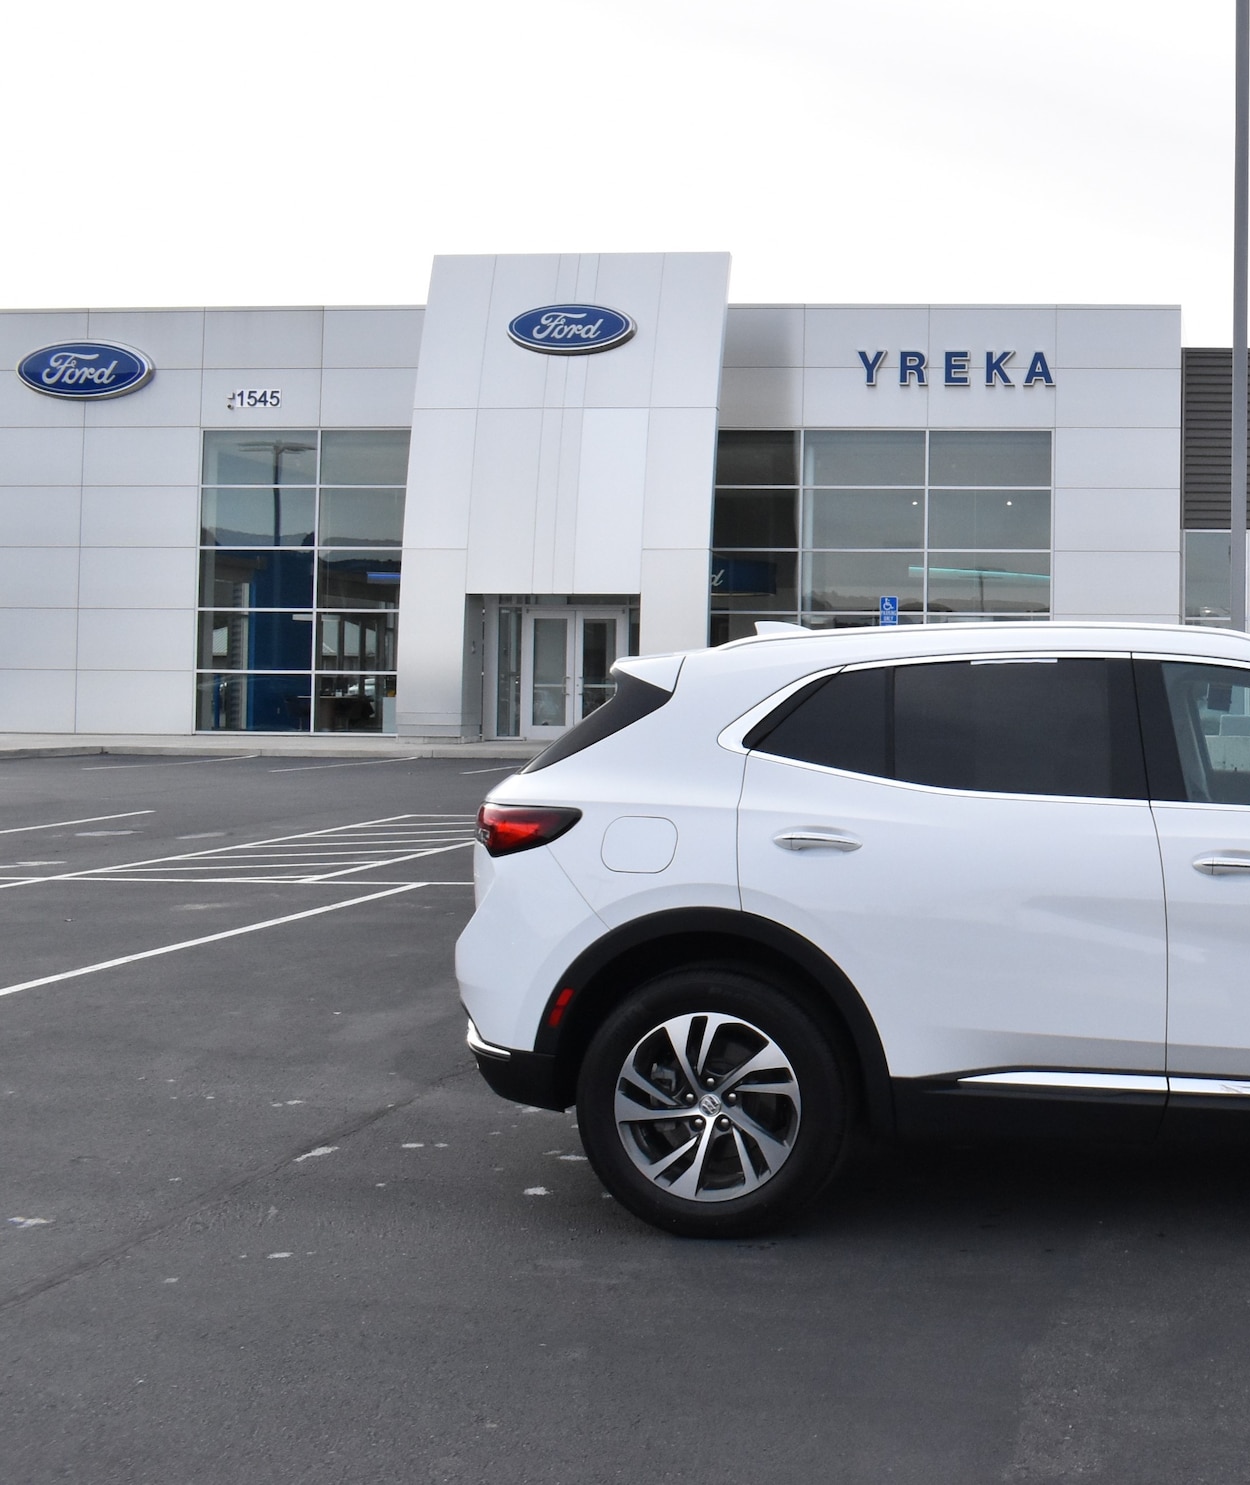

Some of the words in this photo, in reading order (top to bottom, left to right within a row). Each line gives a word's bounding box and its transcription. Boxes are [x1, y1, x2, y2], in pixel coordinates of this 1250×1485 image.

[532, 312, 604, 339] Ford
[41, 352, 119, 384] Ford
[856, 350, 1056, 387] YREKA
[236, 390, 281, 407] 1545
